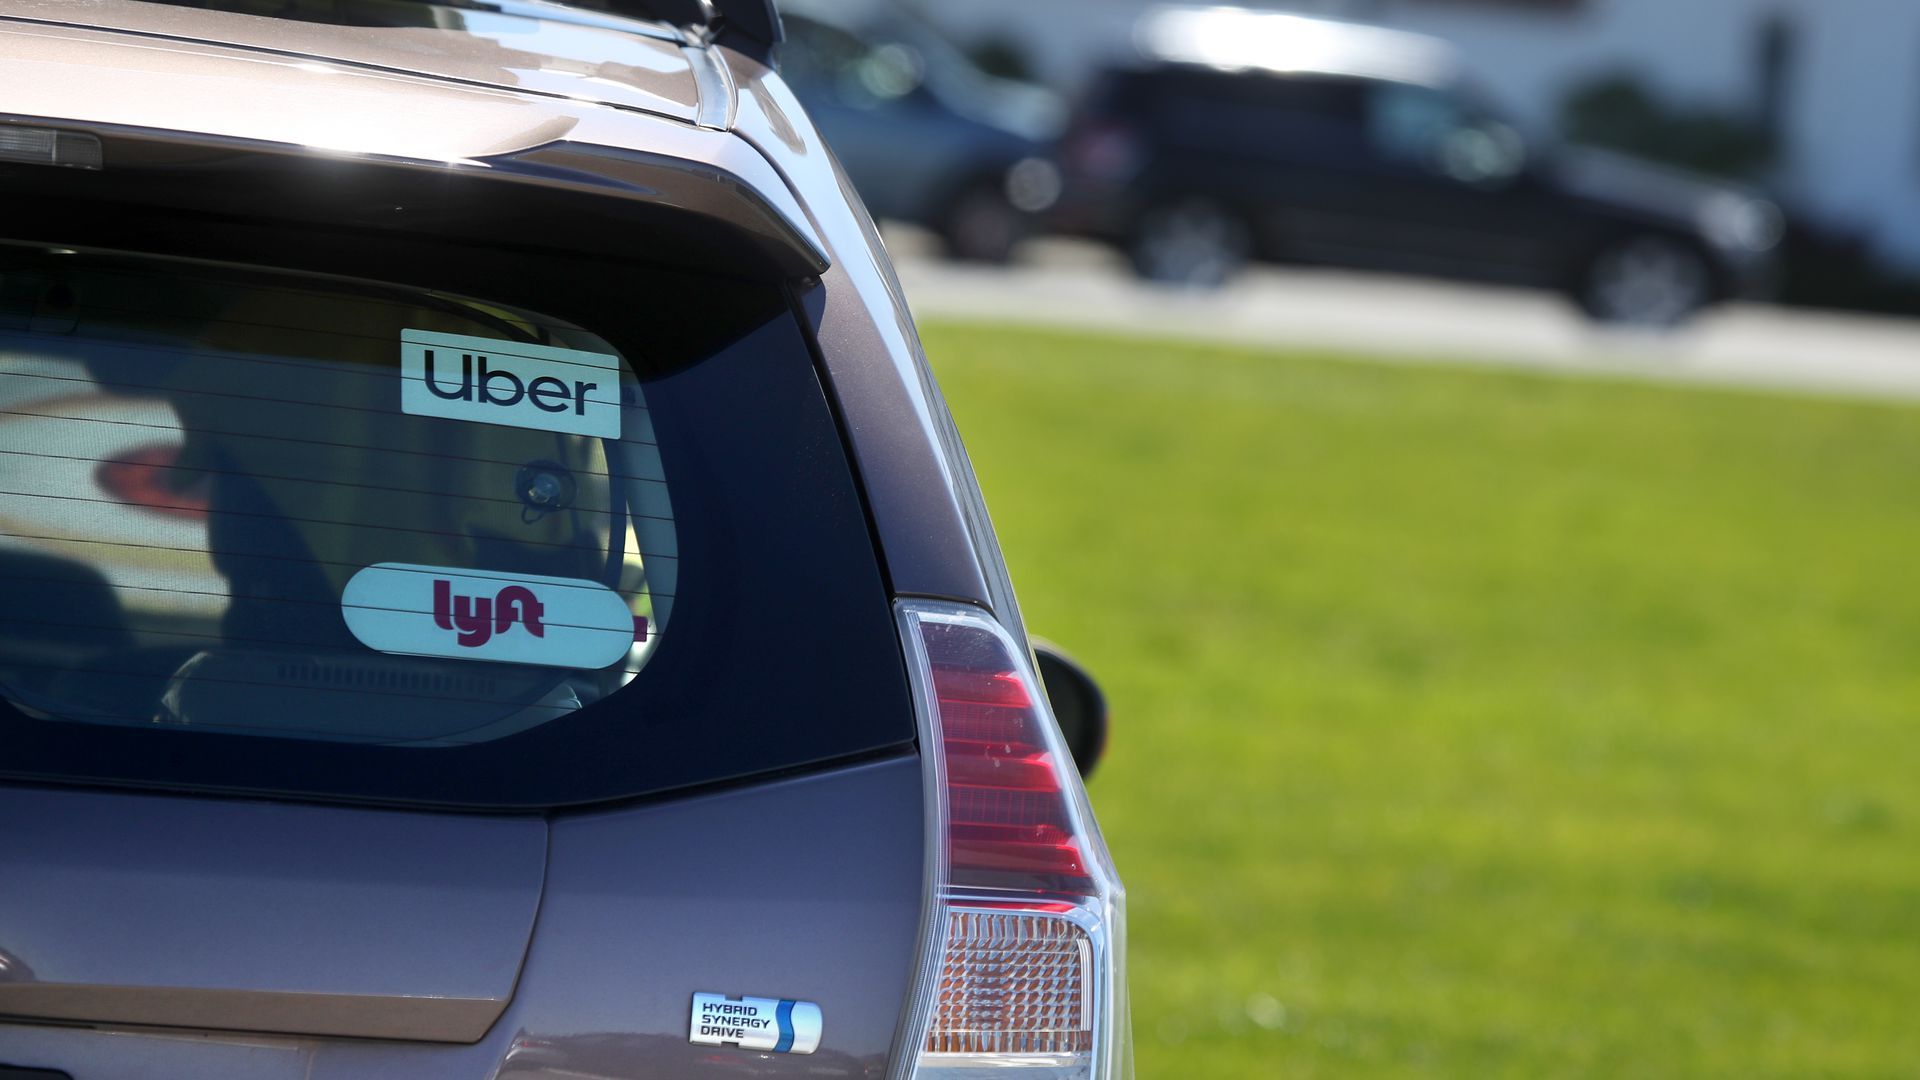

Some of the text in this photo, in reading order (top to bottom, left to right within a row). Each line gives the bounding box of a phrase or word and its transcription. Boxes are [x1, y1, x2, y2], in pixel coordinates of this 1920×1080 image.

[424, 350, 597, 416] Uber
[433, 579, 544, 647] lyft
[703, 1002, 757, 1016] HYBRID
[701, 1014, 770, 1029] SYNERGY
[700, 1025, 745, 1039] DRIVE
